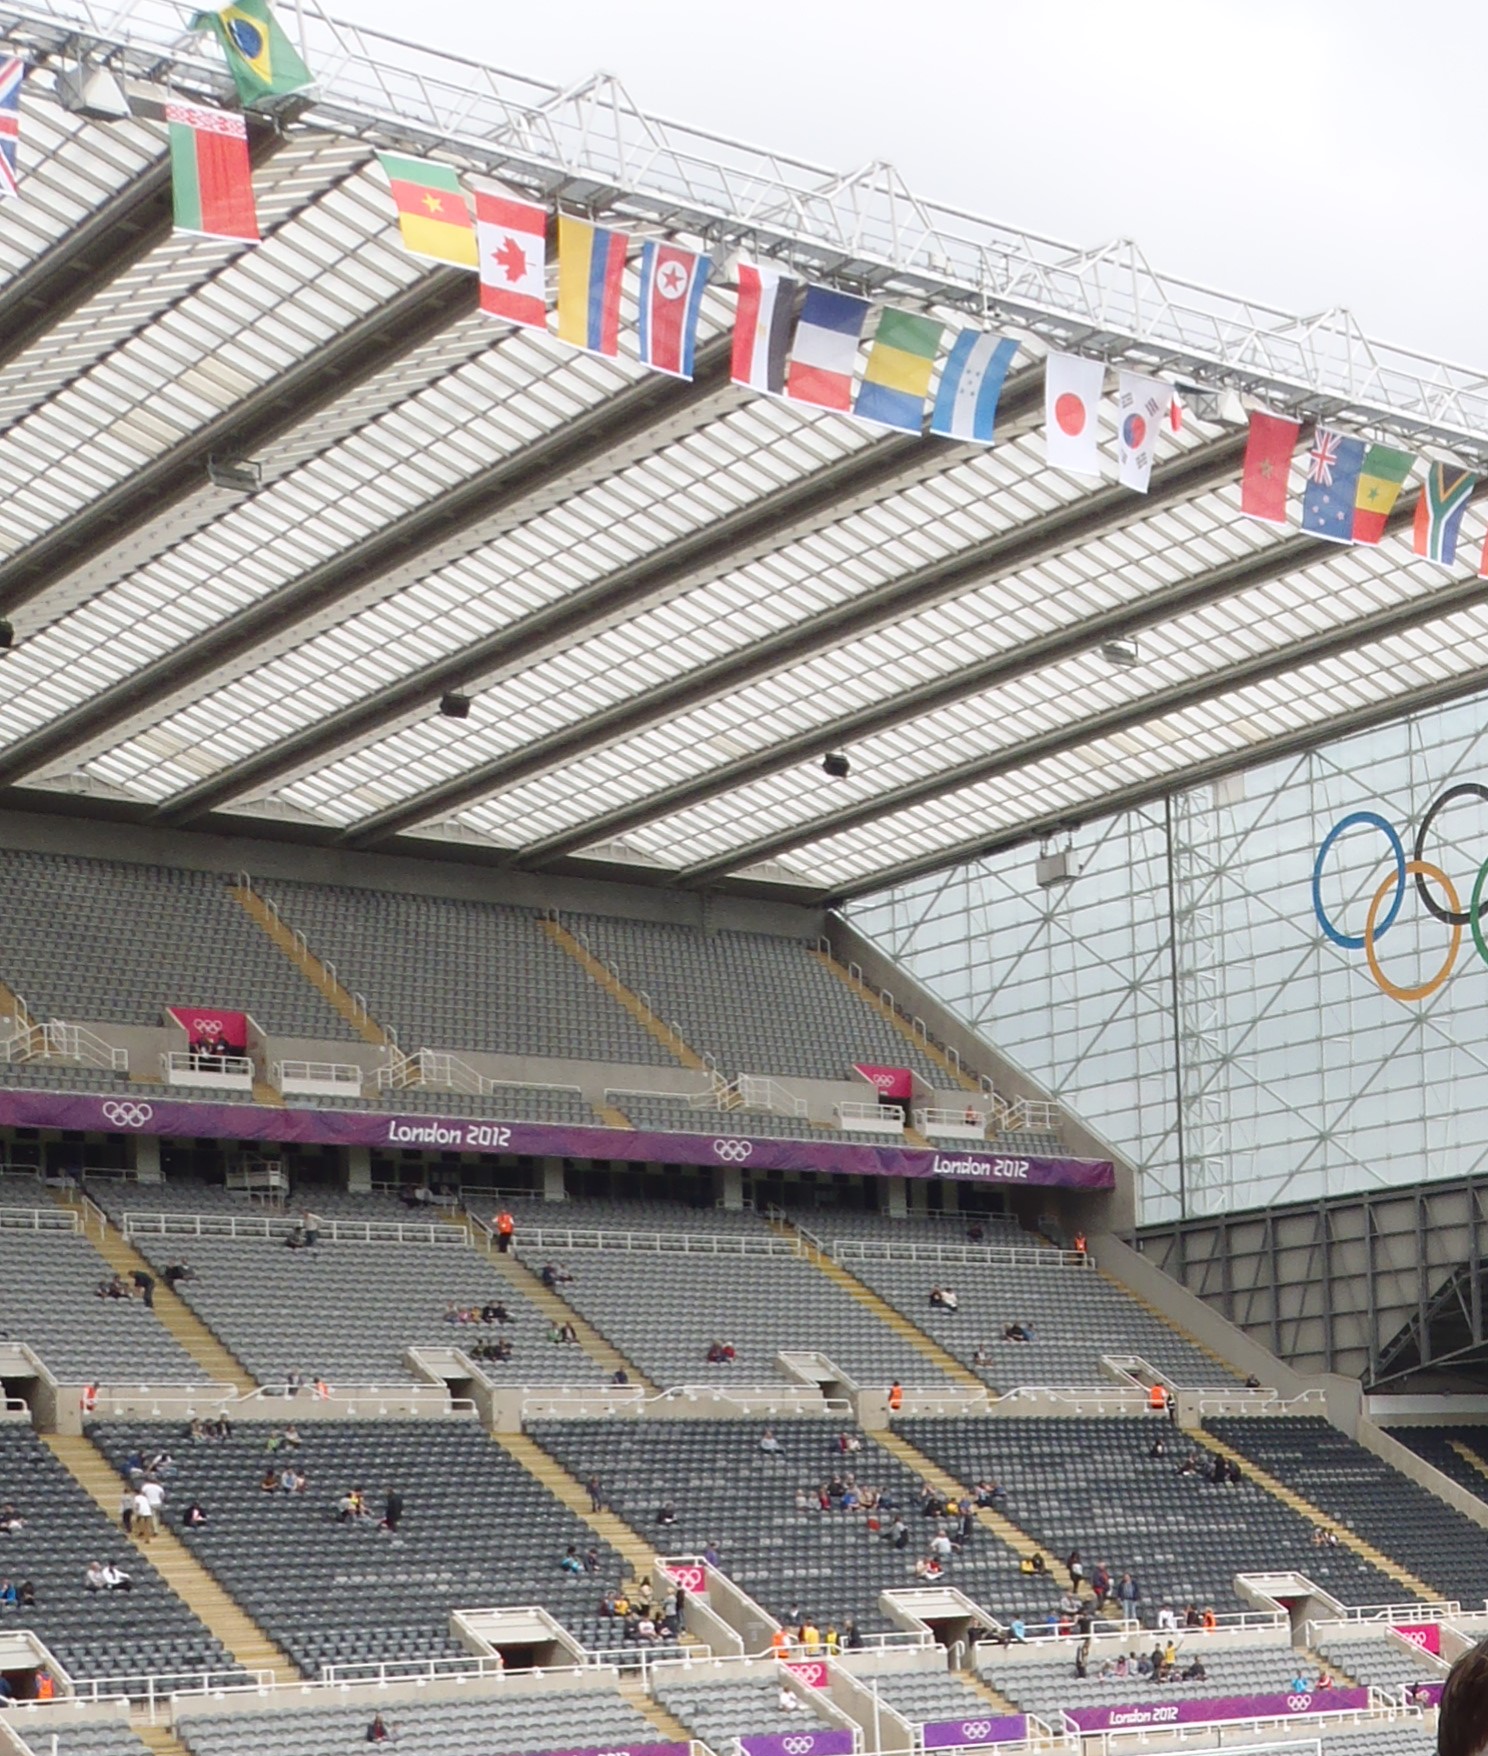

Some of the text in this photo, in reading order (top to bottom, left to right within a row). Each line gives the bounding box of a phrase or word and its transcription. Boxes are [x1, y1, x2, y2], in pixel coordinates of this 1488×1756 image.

[389, 1120, 512, 1147] London 2012
[933, 1154, 1030, 1178] London 2012
[1109, 1706, 1179, 1725] London 2012
